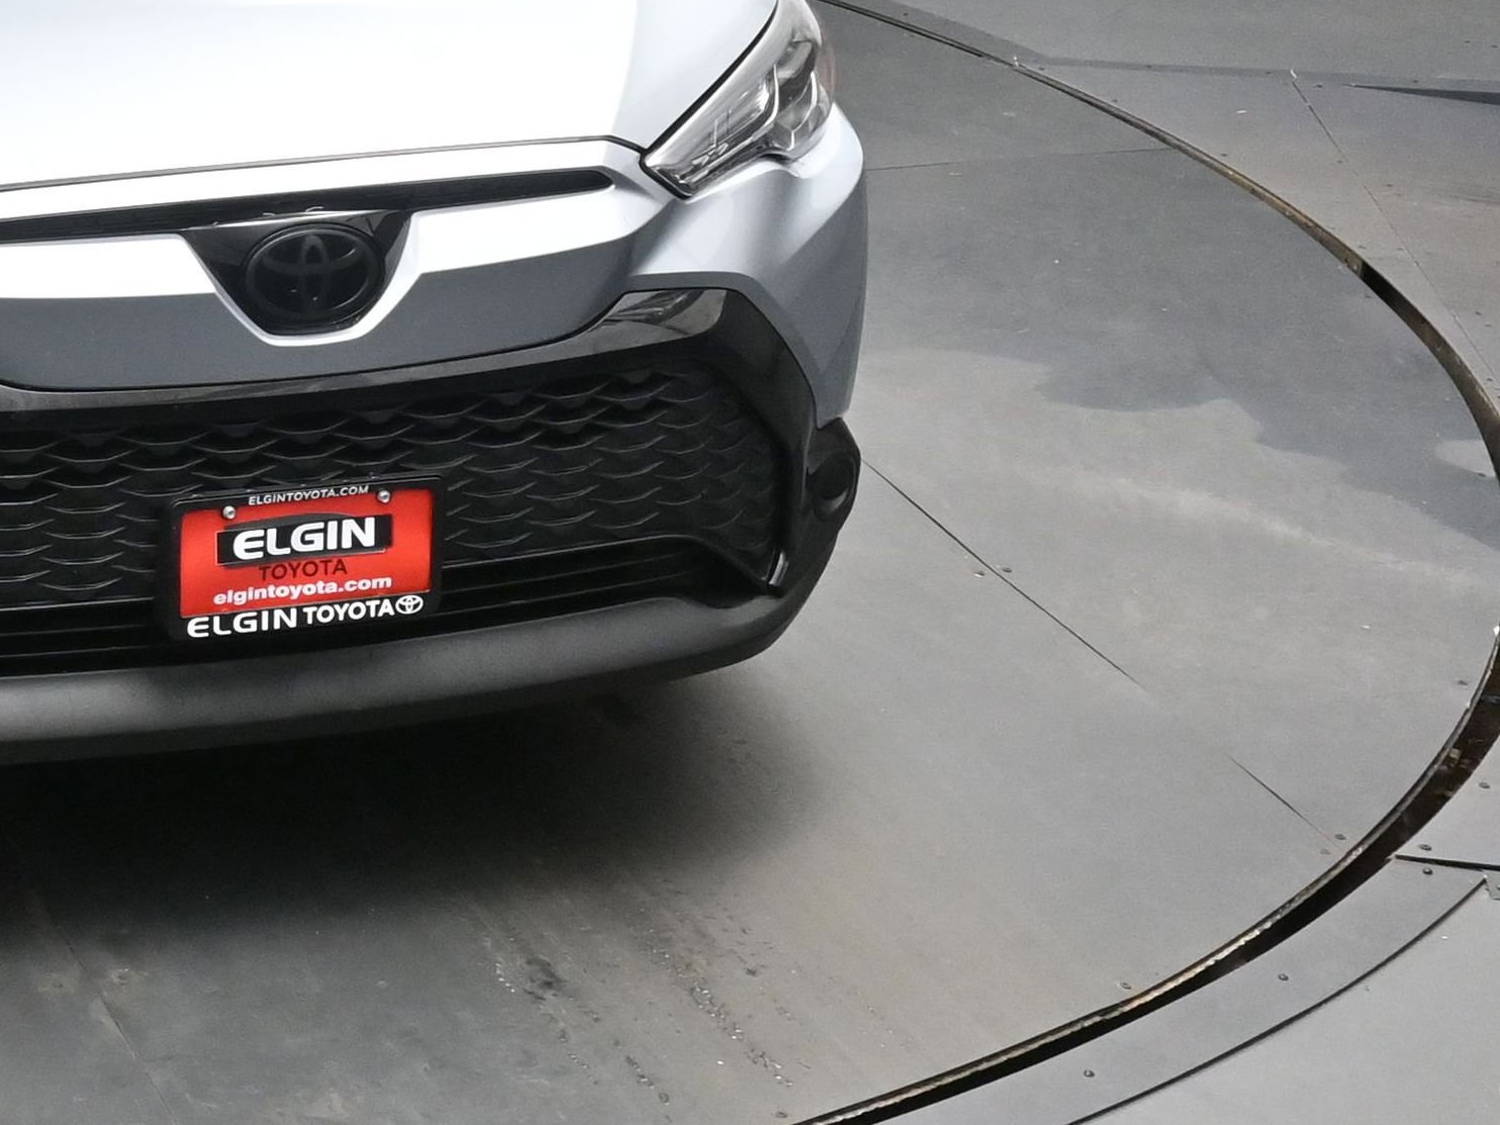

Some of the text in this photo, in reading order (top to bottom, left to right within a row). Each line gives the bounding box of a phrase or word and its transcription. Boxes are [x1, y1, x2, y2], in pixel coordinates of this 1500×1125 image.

[247, 484, 370, 506] ELGINTOYOTA.COM
[232, 516, 376, 561] ELGIN
[258, 558, 348, 582] TOYOTA
[212, 575, 392, 606] elgintoyota.com
[186, 598, 395, 638] ELGIN TOYOTA
